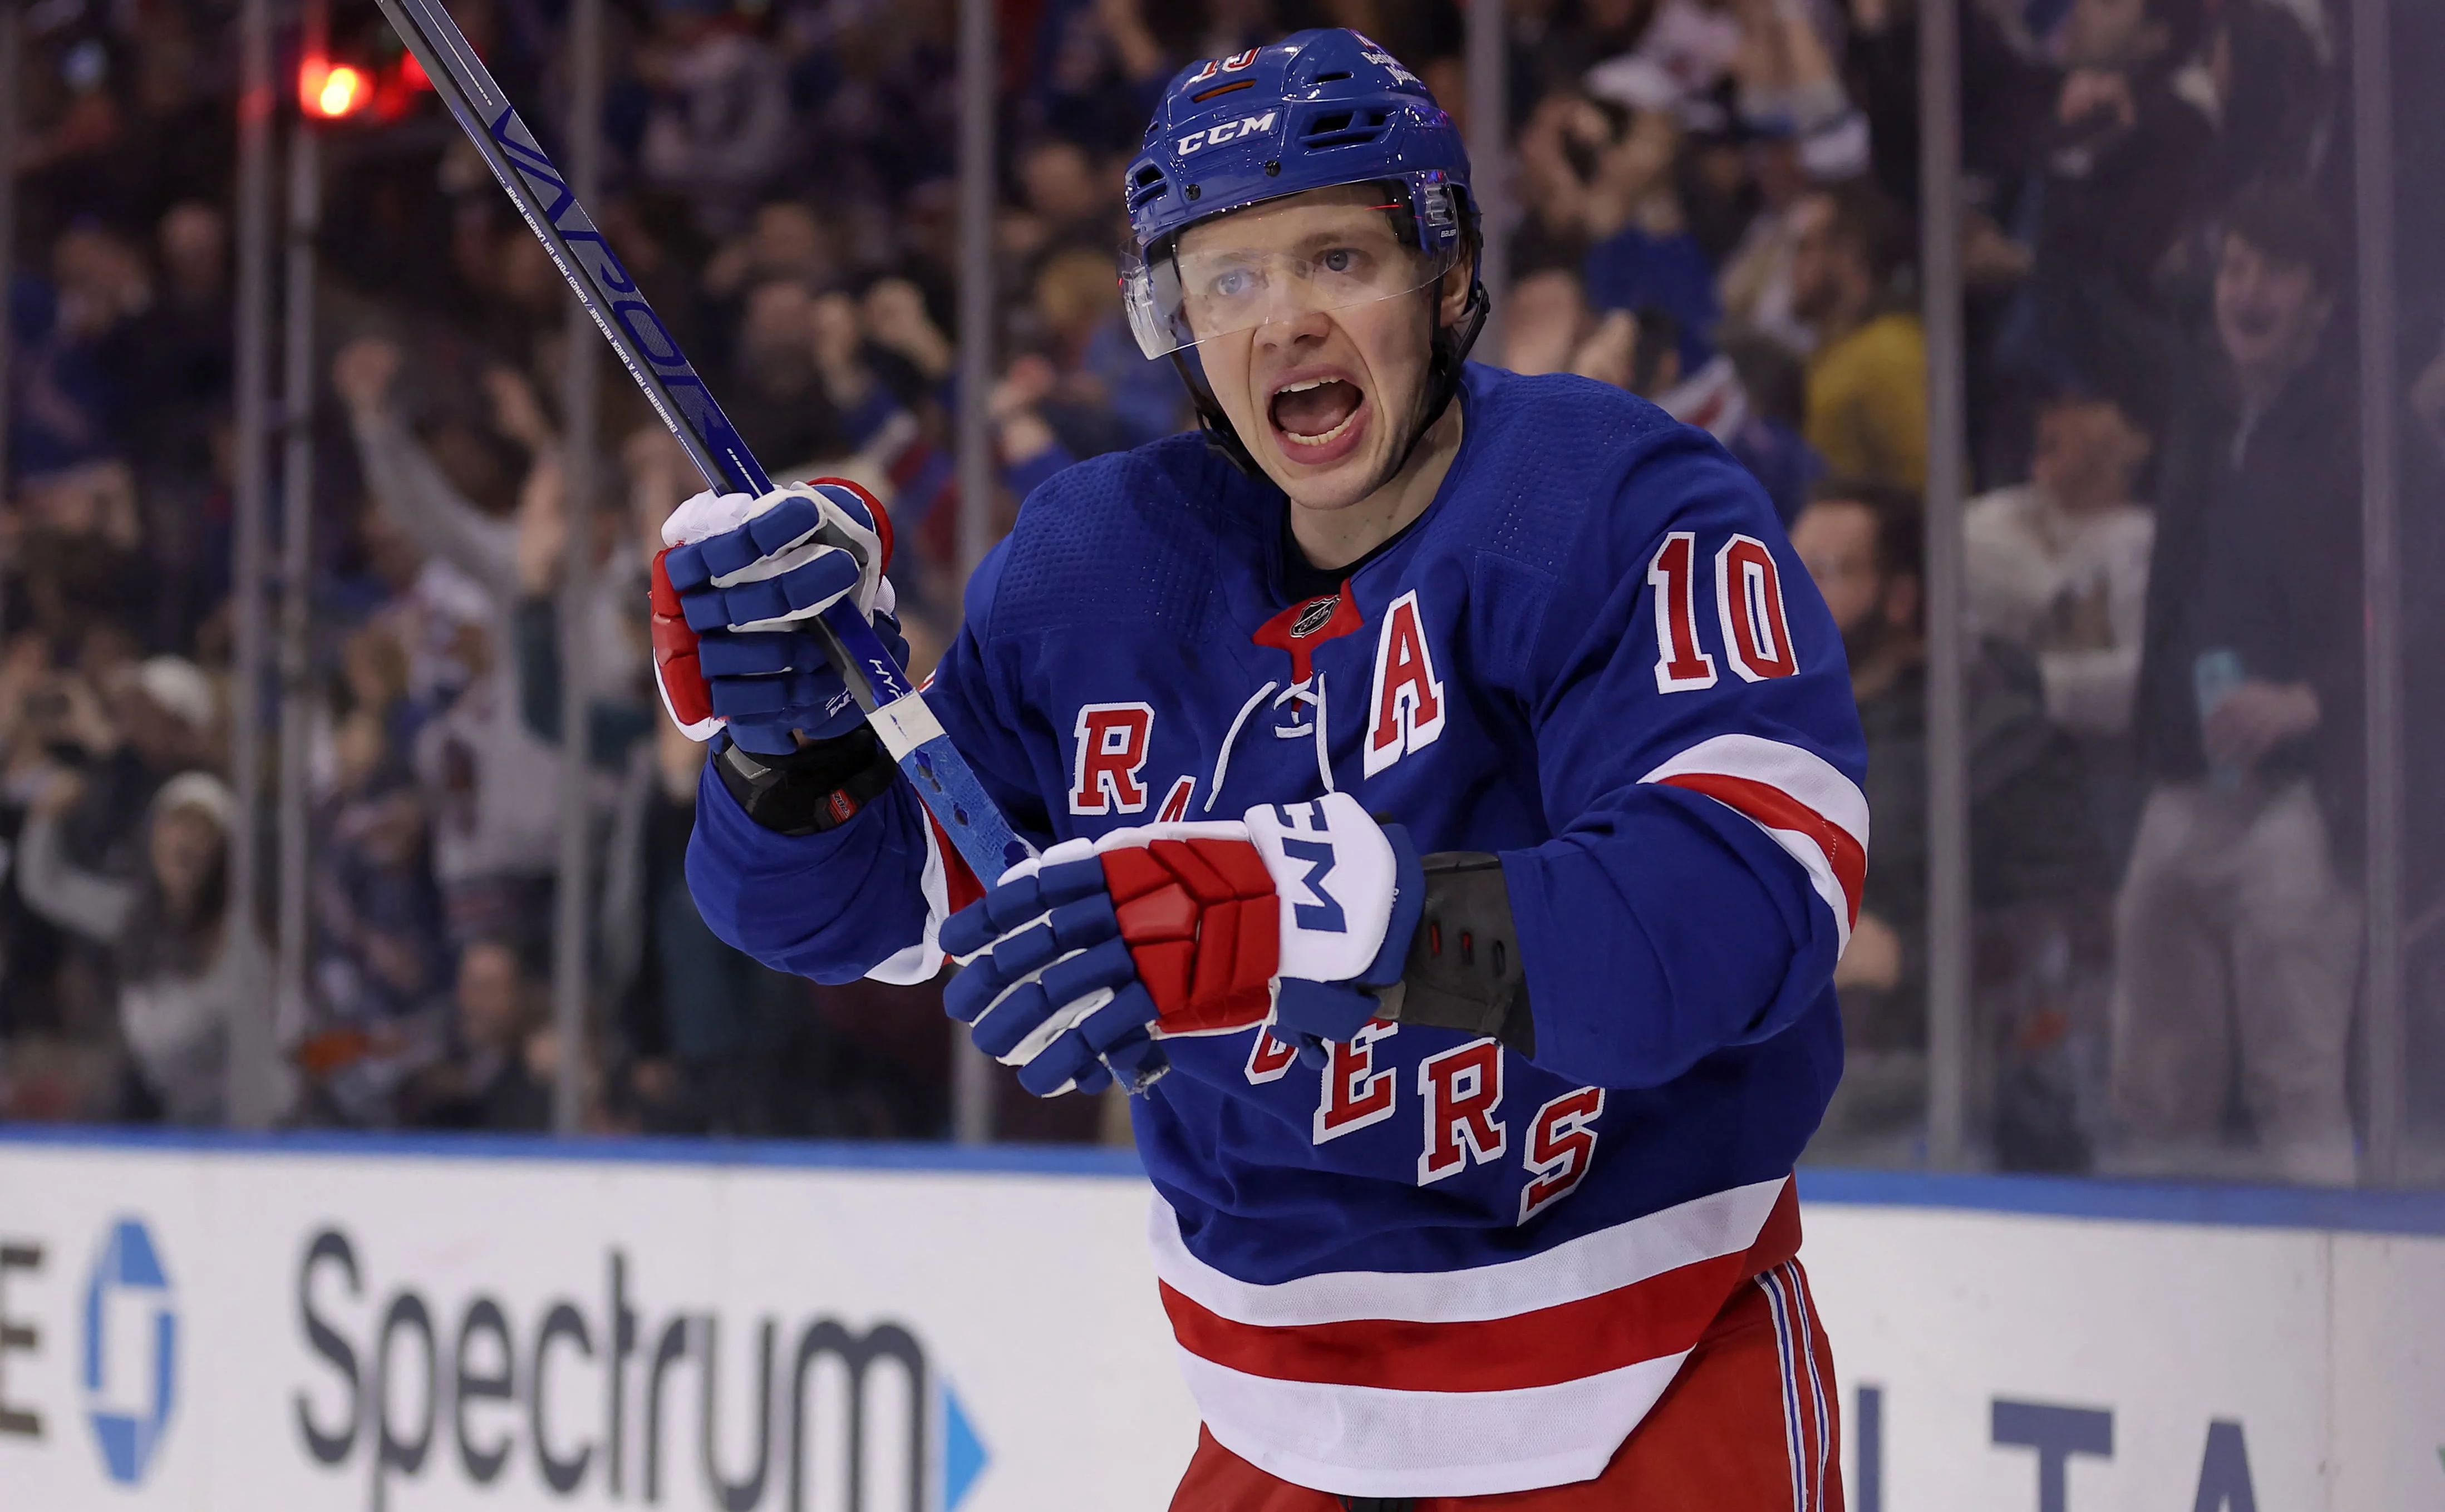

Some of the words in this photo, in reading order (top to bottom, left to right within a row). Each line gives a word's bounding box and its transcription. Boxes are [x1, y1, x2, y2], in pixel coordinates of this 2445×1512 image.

[1177, 112, 1276, 156] CCM
[505, 185, 527, 213] RAPIDE
[524, 213, 547, 242] LANCER
[544, 242, 555, 255] UN
[553, 254, 569, 276] POUR
[567, 277, 587, 303] CONÇU
[589, 307, 614, 340] RELEASE
[611, 339, 630, 363] QUICK
[632, 371, 646, 387] FOR
[644, 387, 678, 433] ENGINEERED
[1647, 531, 1800, 695] 10
[1363, 589, 1446, 780] A
[292, 1228, 927, 1512] Spectrum
